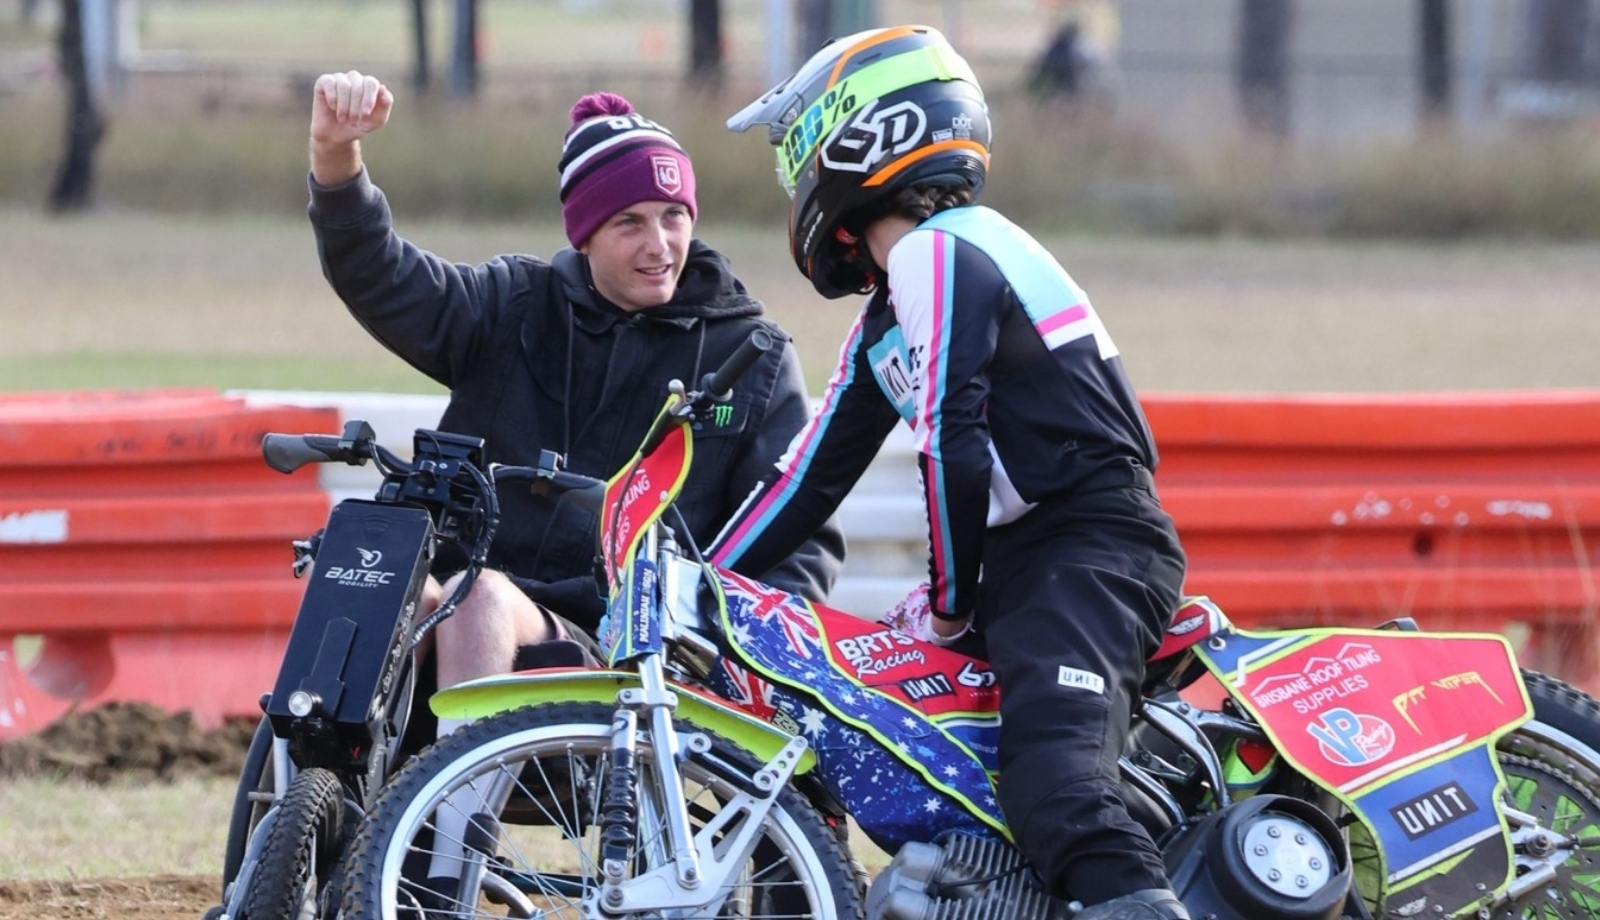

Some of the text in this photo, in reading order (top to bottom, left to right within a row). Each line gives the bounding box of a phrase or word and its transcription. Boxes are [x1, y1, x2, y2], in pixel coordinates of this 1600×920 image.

[784, 81, 856, 176] 100%
[952, 116, 973, 130] DOT
[325, 567, 395, 584] BATEC
[338, 580, 379, 588] MOBILITY
[835, 629, 914, 661] BRTS
[852, 649, 925, 679] Racing
[1063, 671, 1099, 687] UNIT
[1253, 648, 1382, 708] BRISBANE ROOF TILING
[904, 674, 952, 700] UNIT
[1292, 674, 1369, 714] SUPPLIES
[1306, 707, 1370, 764] VP
[1396, 787, 1468, 834] UNIT
